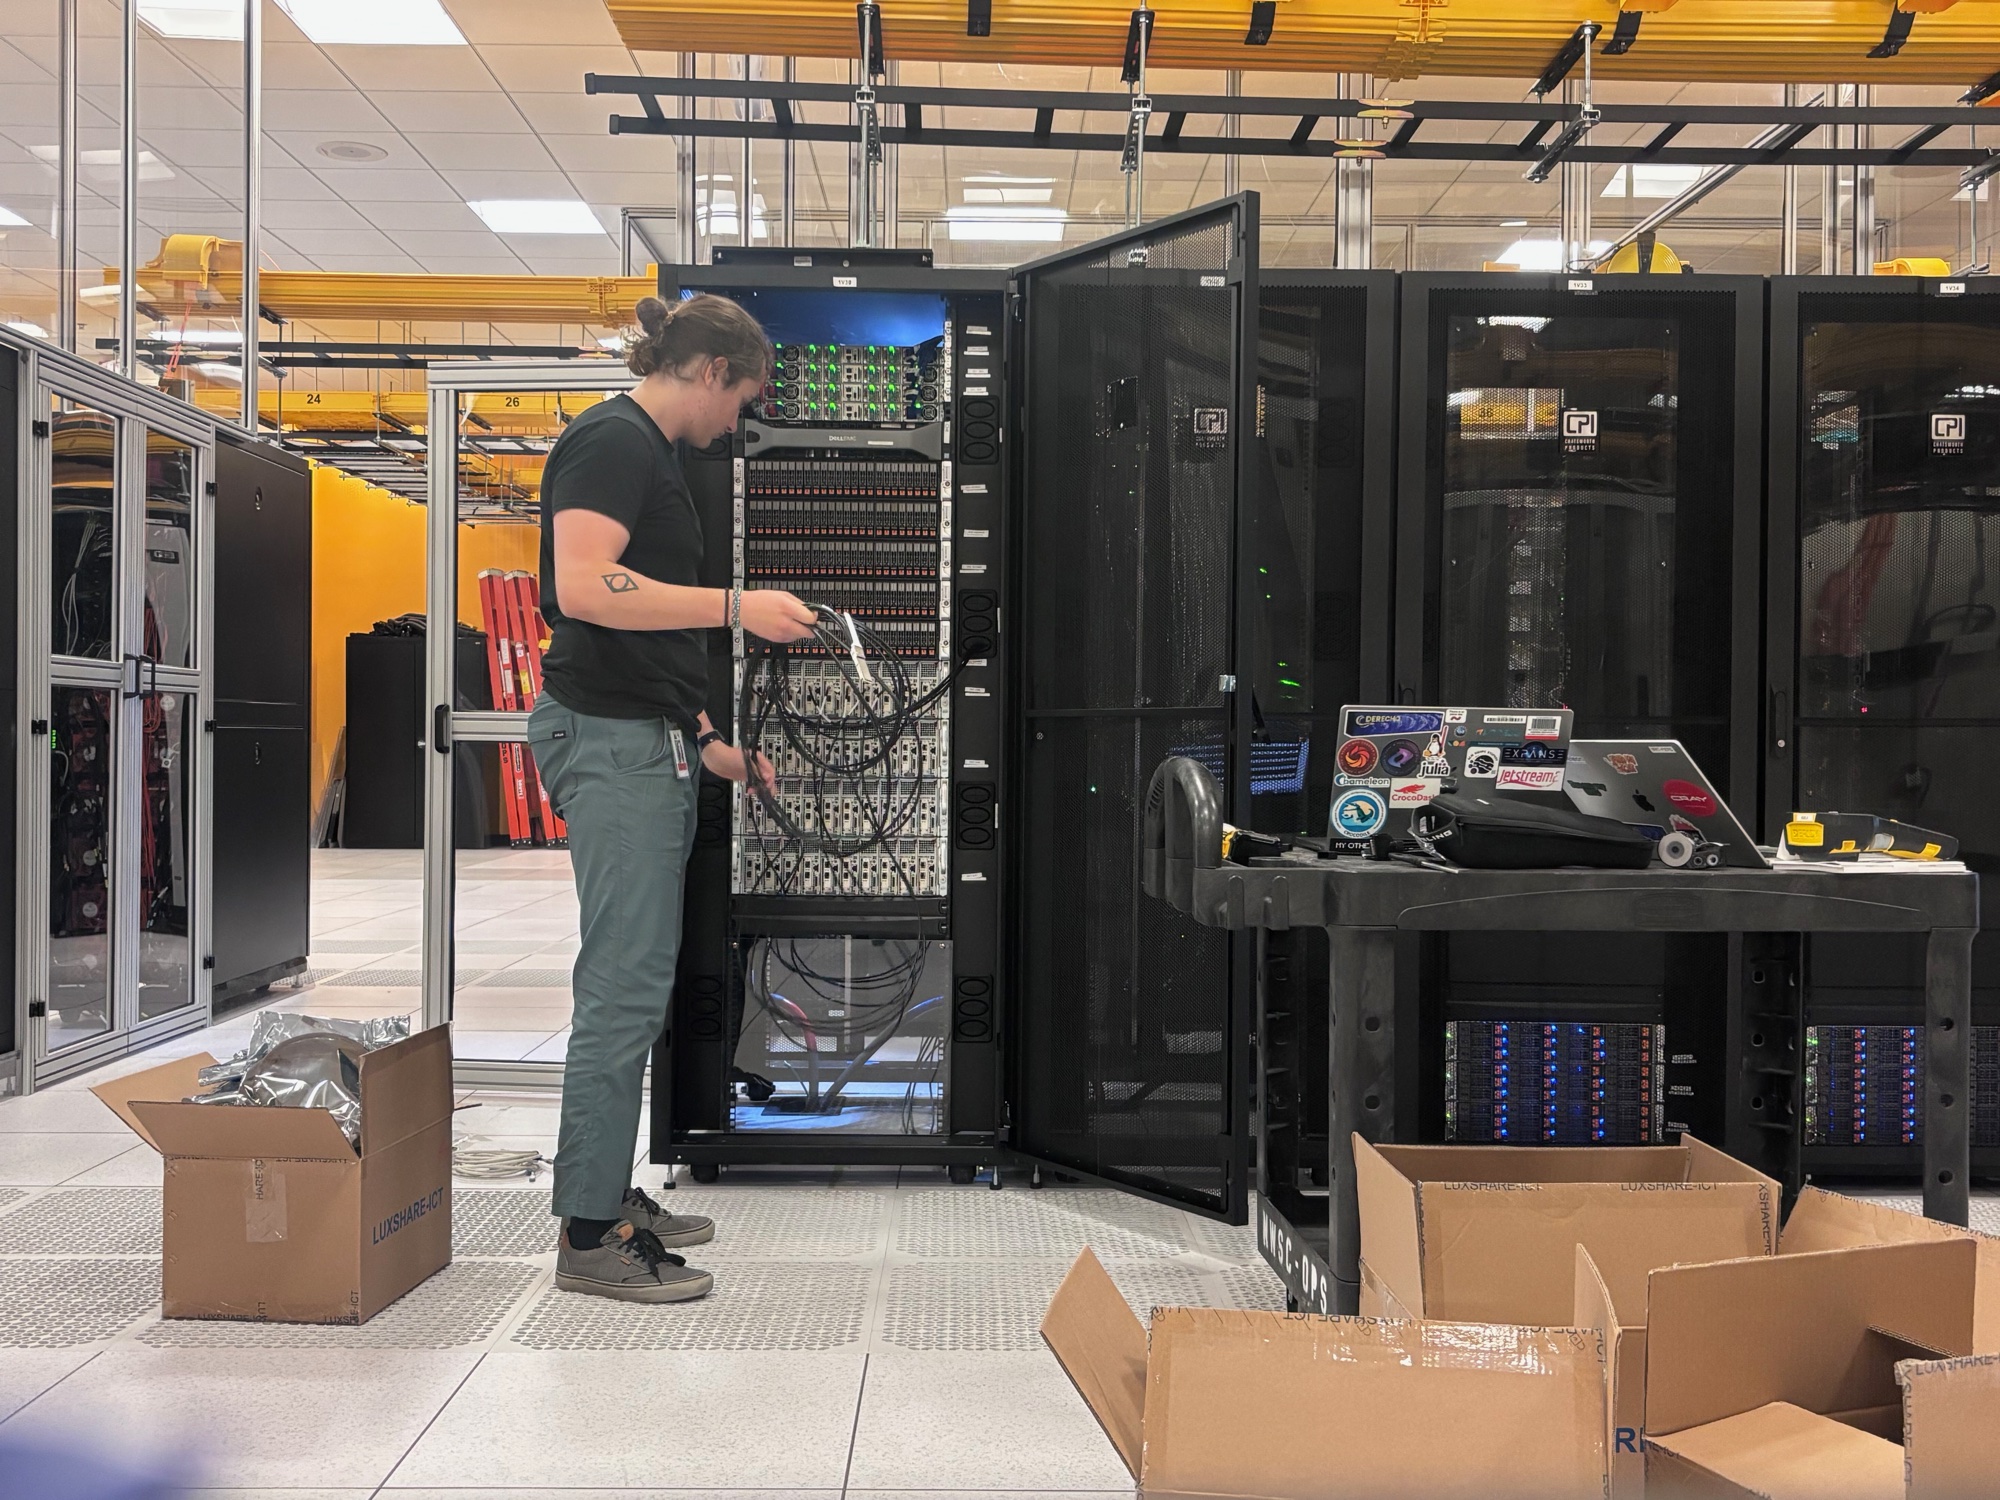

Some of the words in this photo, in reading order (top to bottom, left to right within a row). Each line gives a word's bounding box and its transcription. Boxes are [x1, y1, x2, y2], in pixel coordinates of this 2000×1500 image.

[306, 394, 321, 404] 24
[505, 397, 520, 407] 26
[373, 1187, 444, 1245] LUXSHARE-ICT
